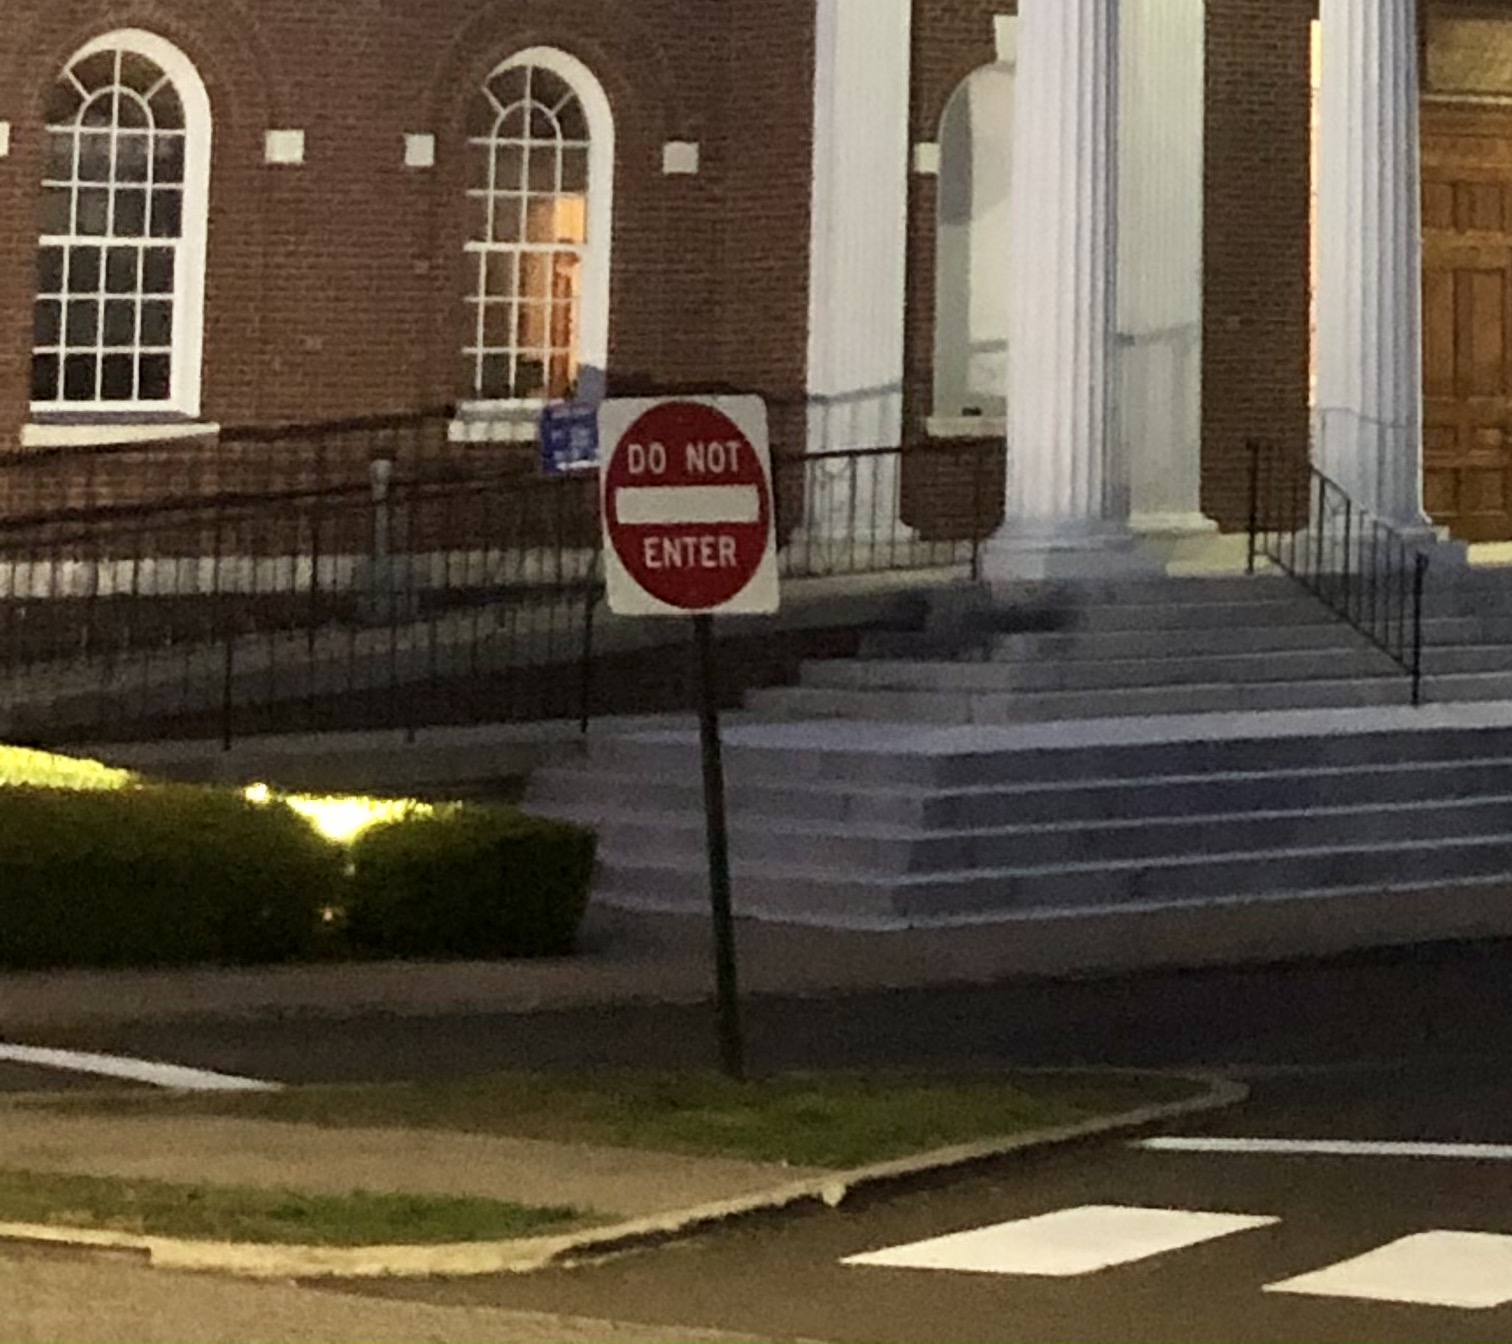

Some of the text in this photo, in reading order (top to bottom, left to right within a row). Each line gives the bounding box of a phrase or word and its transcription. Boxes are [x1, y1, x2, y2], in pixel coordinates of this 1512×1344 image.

[628, 441, 742, 474] DO NOT
[643, 536, 737, 568] ENTER
